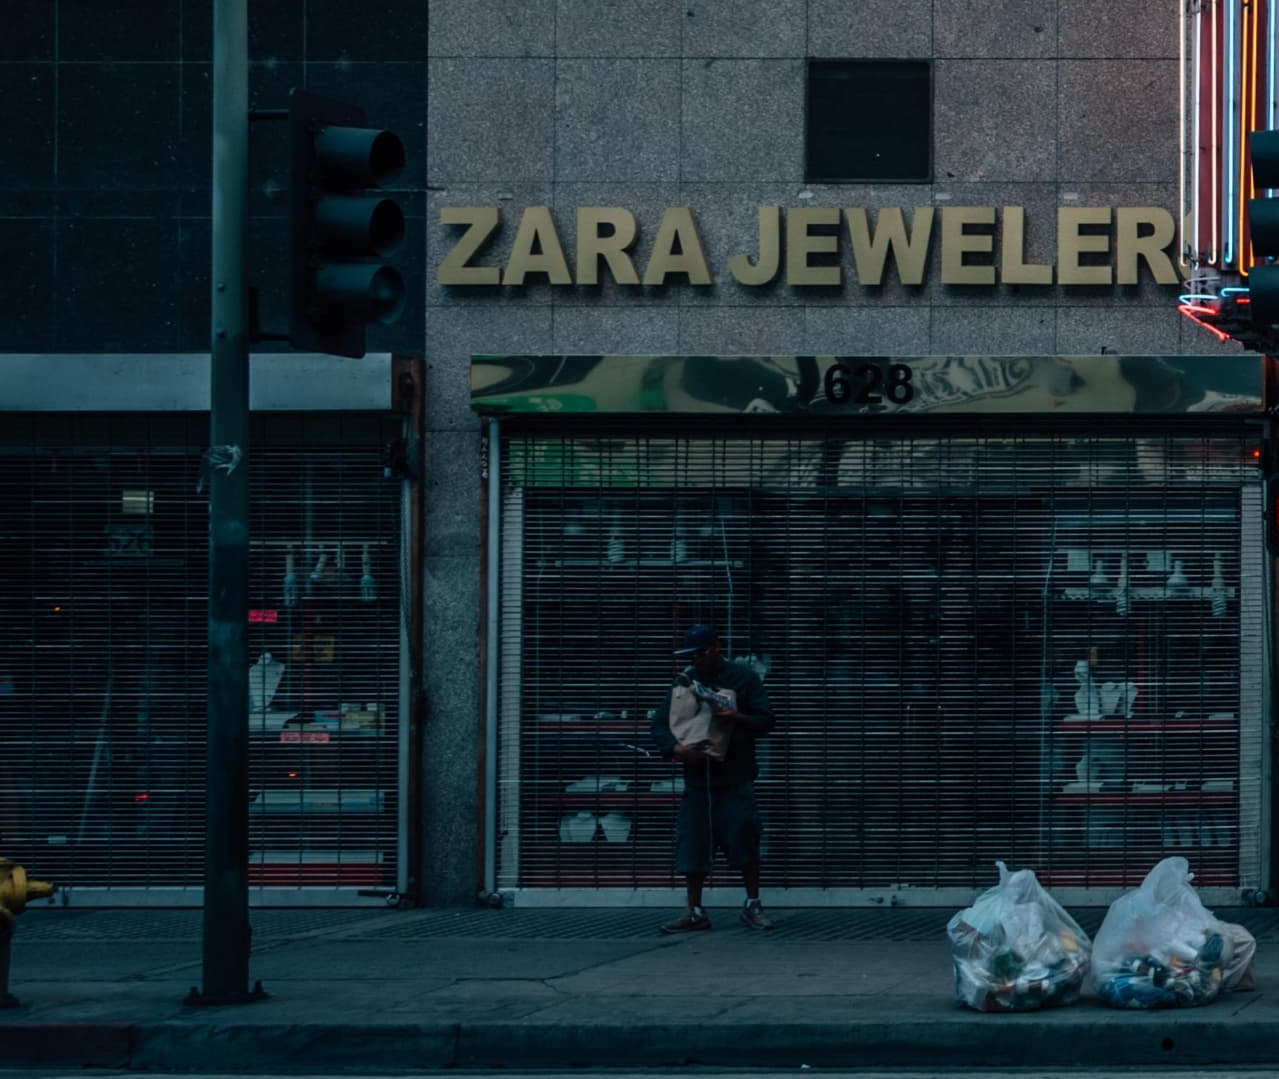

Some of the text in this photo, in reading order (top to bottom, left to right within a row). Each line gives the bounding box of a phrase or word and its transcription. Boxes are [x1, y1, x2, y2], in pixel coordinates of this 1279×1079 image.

[437, 206, 1193, 286] ZARA JEWELER
[824, 363, 914, 405] 628
